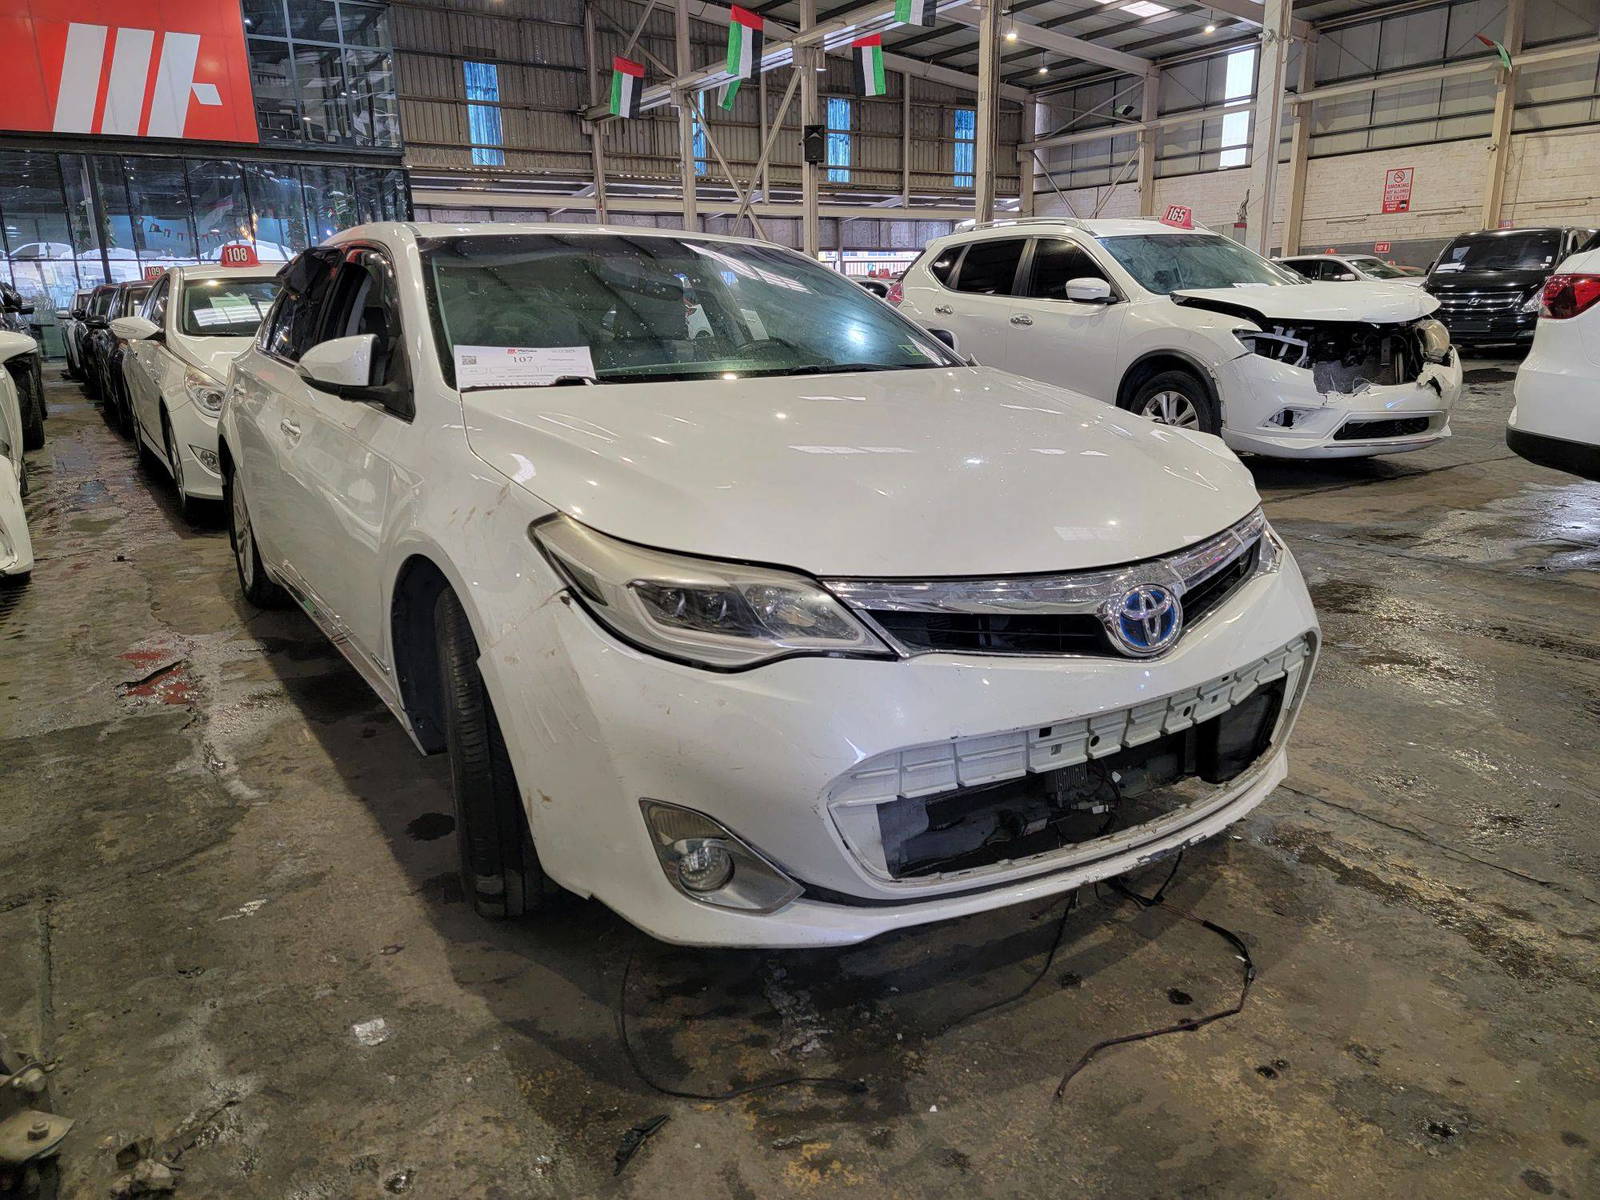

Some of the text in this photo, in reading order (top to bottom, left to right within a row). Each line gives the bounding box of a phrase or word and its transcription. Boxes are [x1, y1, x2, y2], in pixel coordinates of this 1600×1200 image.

[1167, 206, 1185, 222] 165
[227, 247, 248, 262] 108
[148, 266, 161, 276] 109
[512, 355, 534, 364] 107
